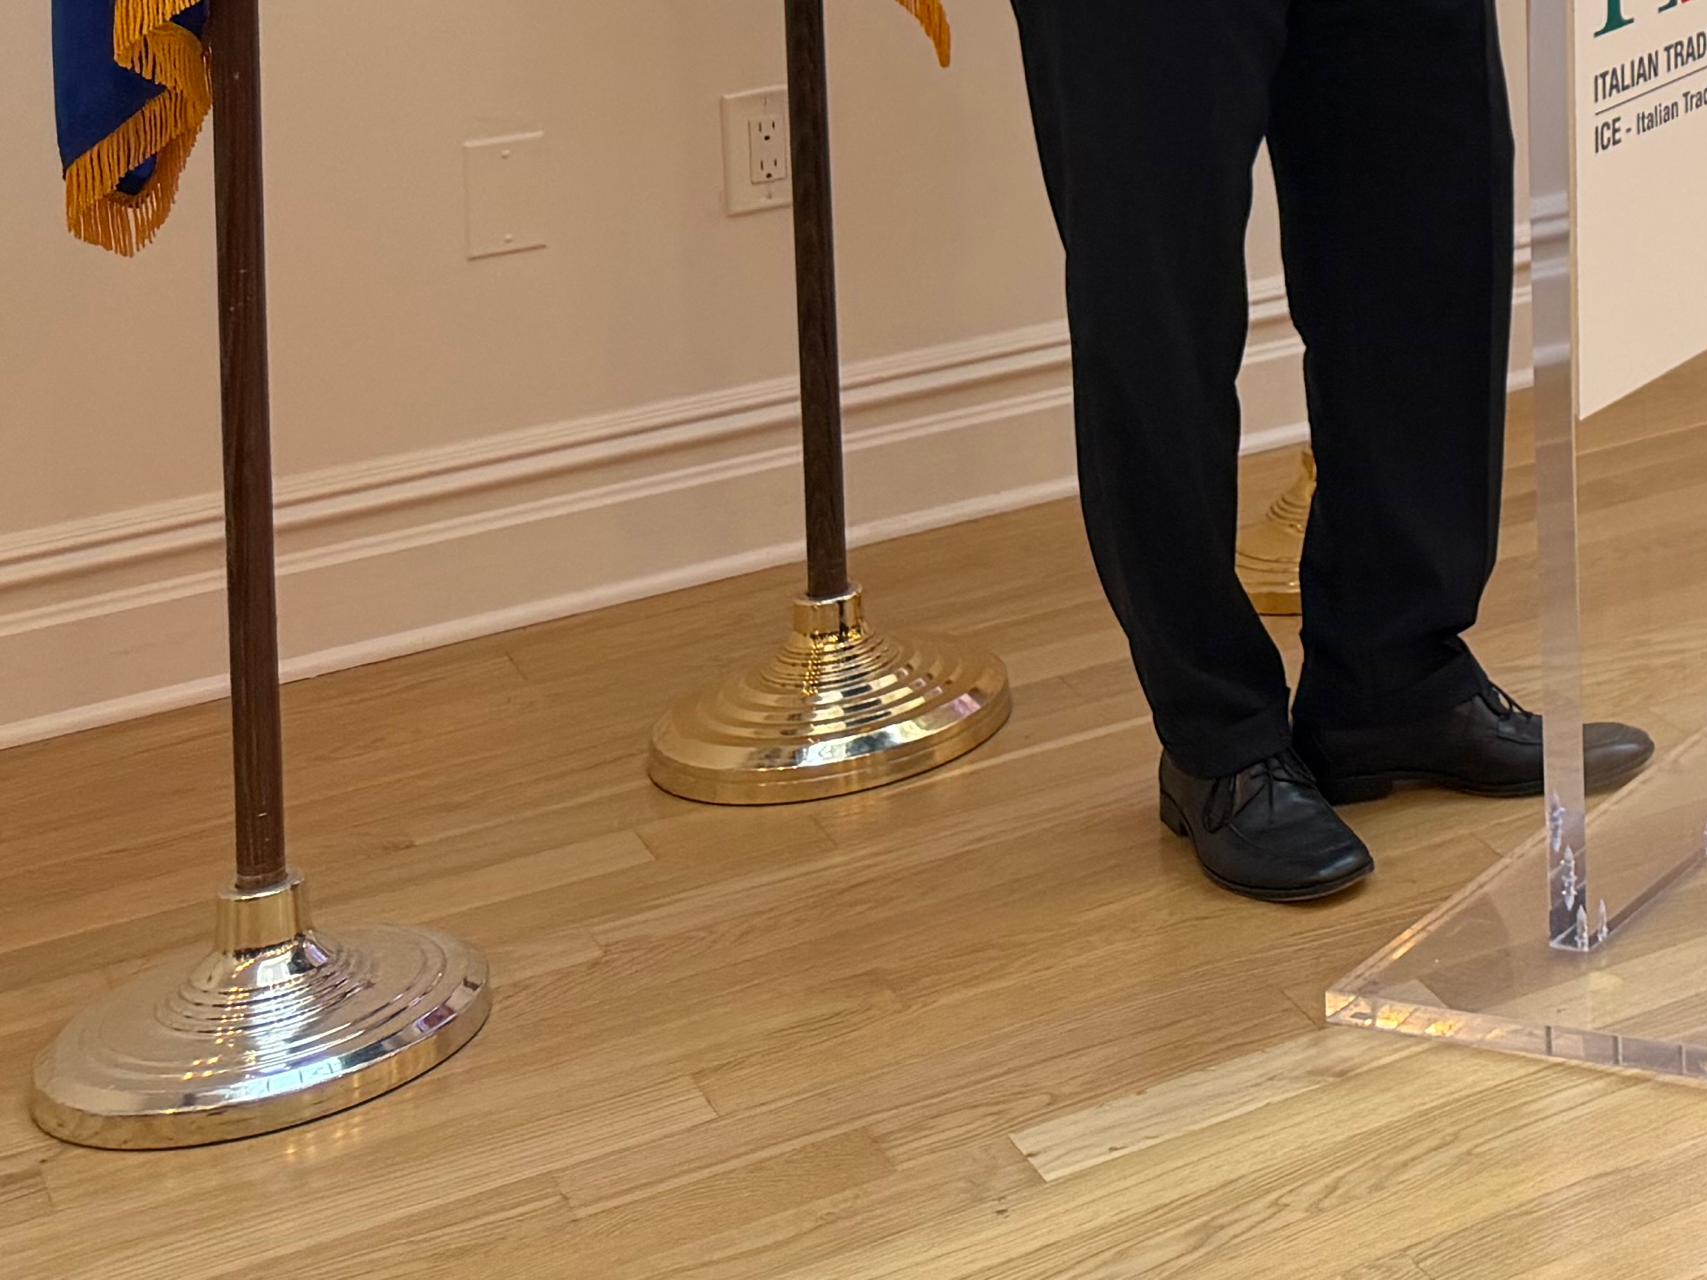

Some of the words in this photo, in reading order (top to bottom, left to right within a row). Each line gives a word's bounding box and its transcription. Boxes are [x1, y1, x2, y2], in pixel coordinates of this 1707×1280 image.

[1594, 49, 1660, 103] ITALIAN
[1594, 116, 1622, 154] ICE
[1636, 98, 1679, 135] Italian
